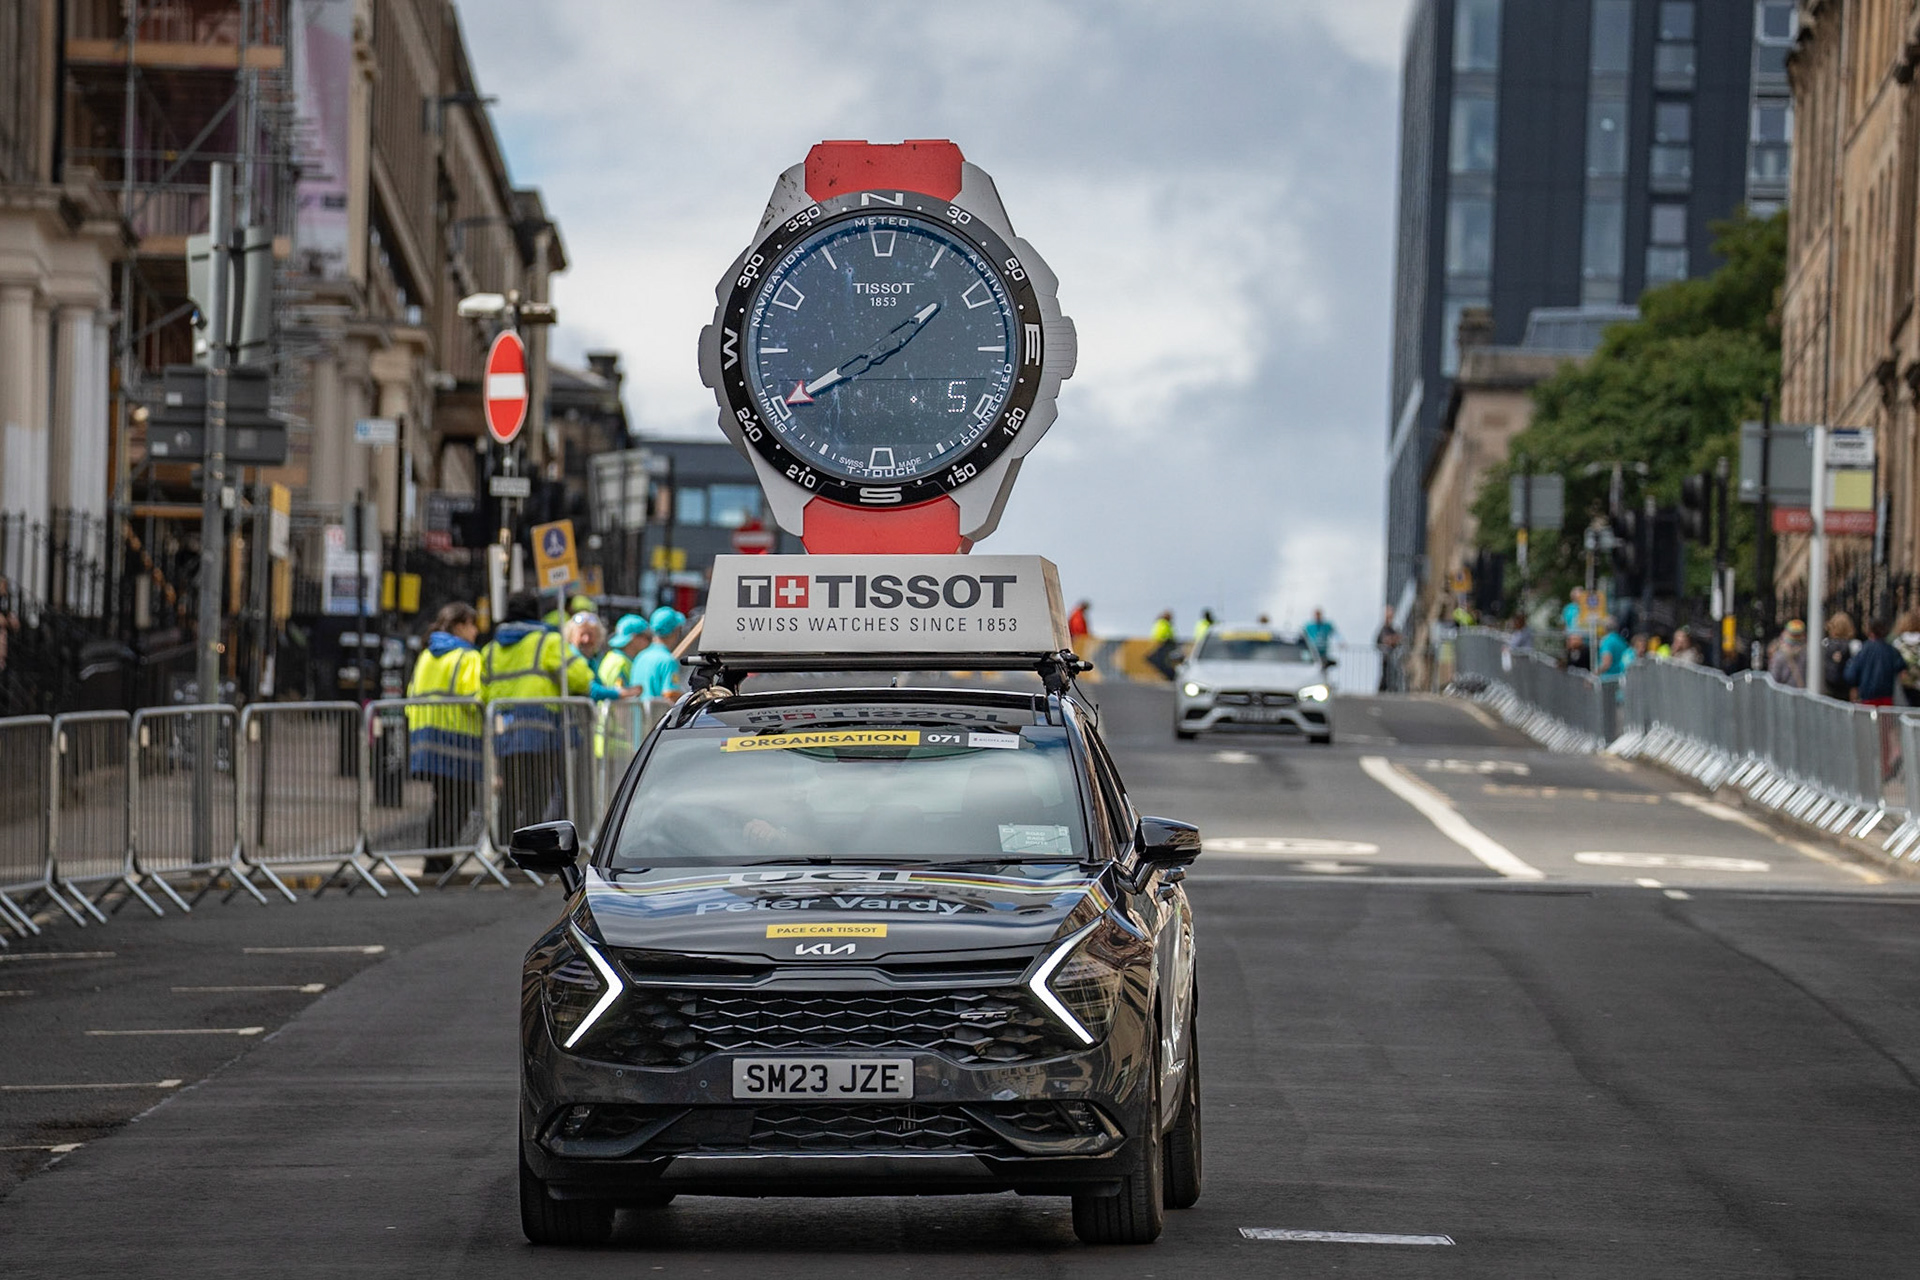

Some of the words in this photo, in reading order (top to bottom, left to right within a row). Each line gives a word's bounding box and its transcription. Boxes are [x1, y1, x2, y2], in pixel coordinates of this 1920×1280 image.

[861, 193, 904, 206] N
[786, 206, 821, 232] 330
[854, 217, 909, 228] METEO
[946, 206, 972, 225] 30
[737, 253, 765, 289] 300
[1005, 257, 1026, 282] 60
[752, 246, 805, 327] NAVIGATION
[852, 282, 915, 295] TISSOT
[968, 253, 1011, 317] ACTIVITY
[869, 297, 897, 307] 1853
[722, 327, 739, 371] W
[1024, 323, 1041, 367] E
[757, 388, 788, 434] TIMING
[960, 363, 1013, 447] CONNECTED
[736, 407, 763, 442] 240
[1003, 407, 1026, 437] 120
[838, 456, 865, 469] SWISS
[897, 457, 922, 468] MADE
[846, 465, 917, 478] T-TOUCH
[785, 464, 817, 489] 210
[946, 463, 977, 487] 150
[859, 486, 902, 503] S
[815, 574, 1017, 609] TISSOT
[736, 616, 799, 632] SWISS
[808, 616, 899, 632] WATCHES
[910, 616, 967, 632] SINCE
[977, 616, 1018, 632] 1853
[739, 733, 907, 747] ORGANISATION
[927, 734, 961, 744] 071
[696, 895, 820, 916] Peter
[830, 895, 966, 916] Vardy
[776, 927, 807, 935] PACE
[809, 926, 834, 935] CAR
[837, 926, 878, 935] TISSOT
[747, 1065, 828, 1092] SM23
[839, 1065, 899, 1092] JZE
